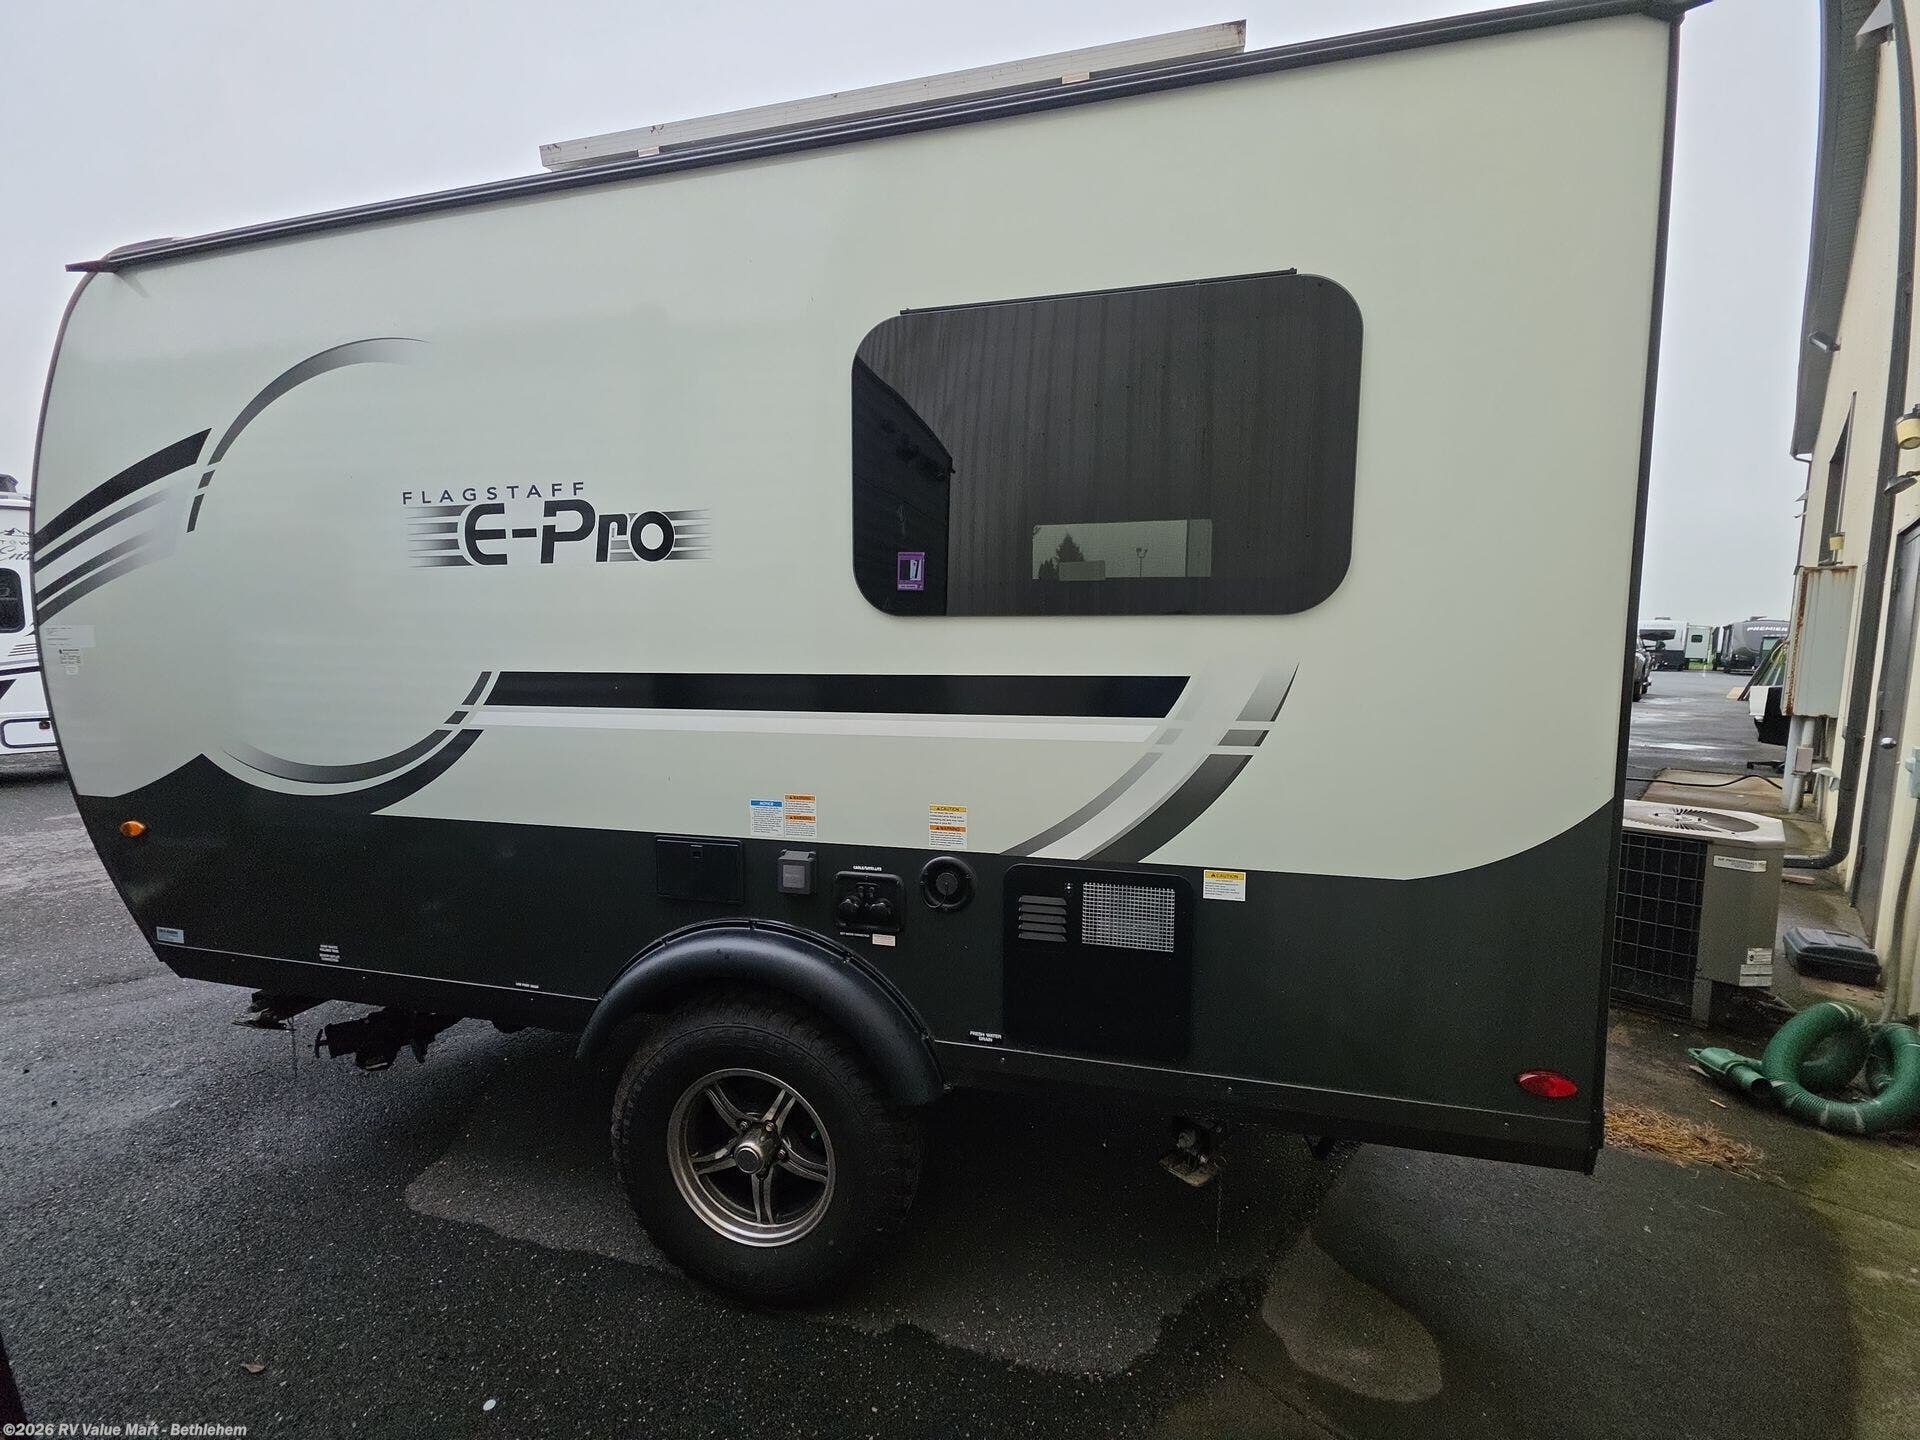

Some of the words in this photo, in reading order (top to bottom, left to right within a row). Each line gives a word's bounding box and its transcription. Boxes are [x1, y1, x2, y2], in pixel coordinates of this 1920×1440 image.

[402, 481, 584, 505] FLAGSTAFF
[464, 498, 675, 566] E-Pro
[985, 1032, 1002, 1040] WATER
